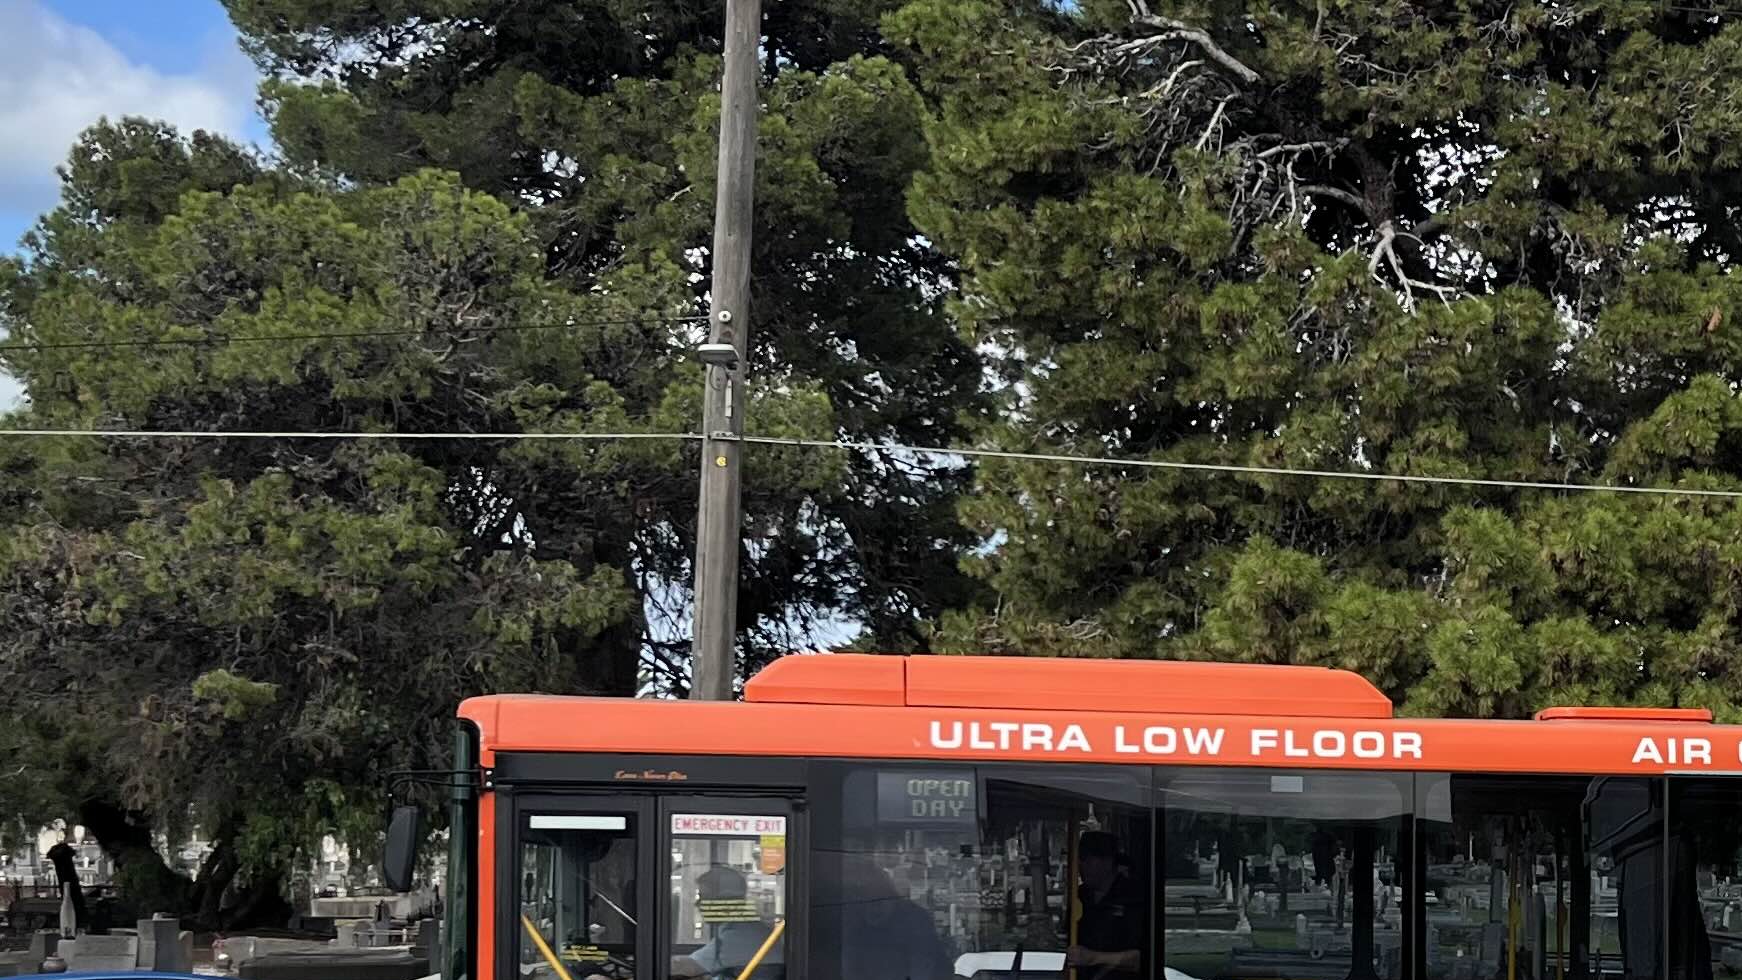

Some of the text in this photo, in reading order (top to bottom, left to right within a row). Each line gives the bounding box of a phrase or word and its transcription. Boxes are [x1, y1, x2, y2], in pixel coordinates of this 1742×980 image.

[930, 721, 1423, 759] ULTRA LOW FLOOR
[1632, 737, 1712, 765] AIR
[907, 780, 971, 797] OPEN
[912, 799, 965, 817] DAY
[674, 817, 783, 833] EMERGENCY EXIT
